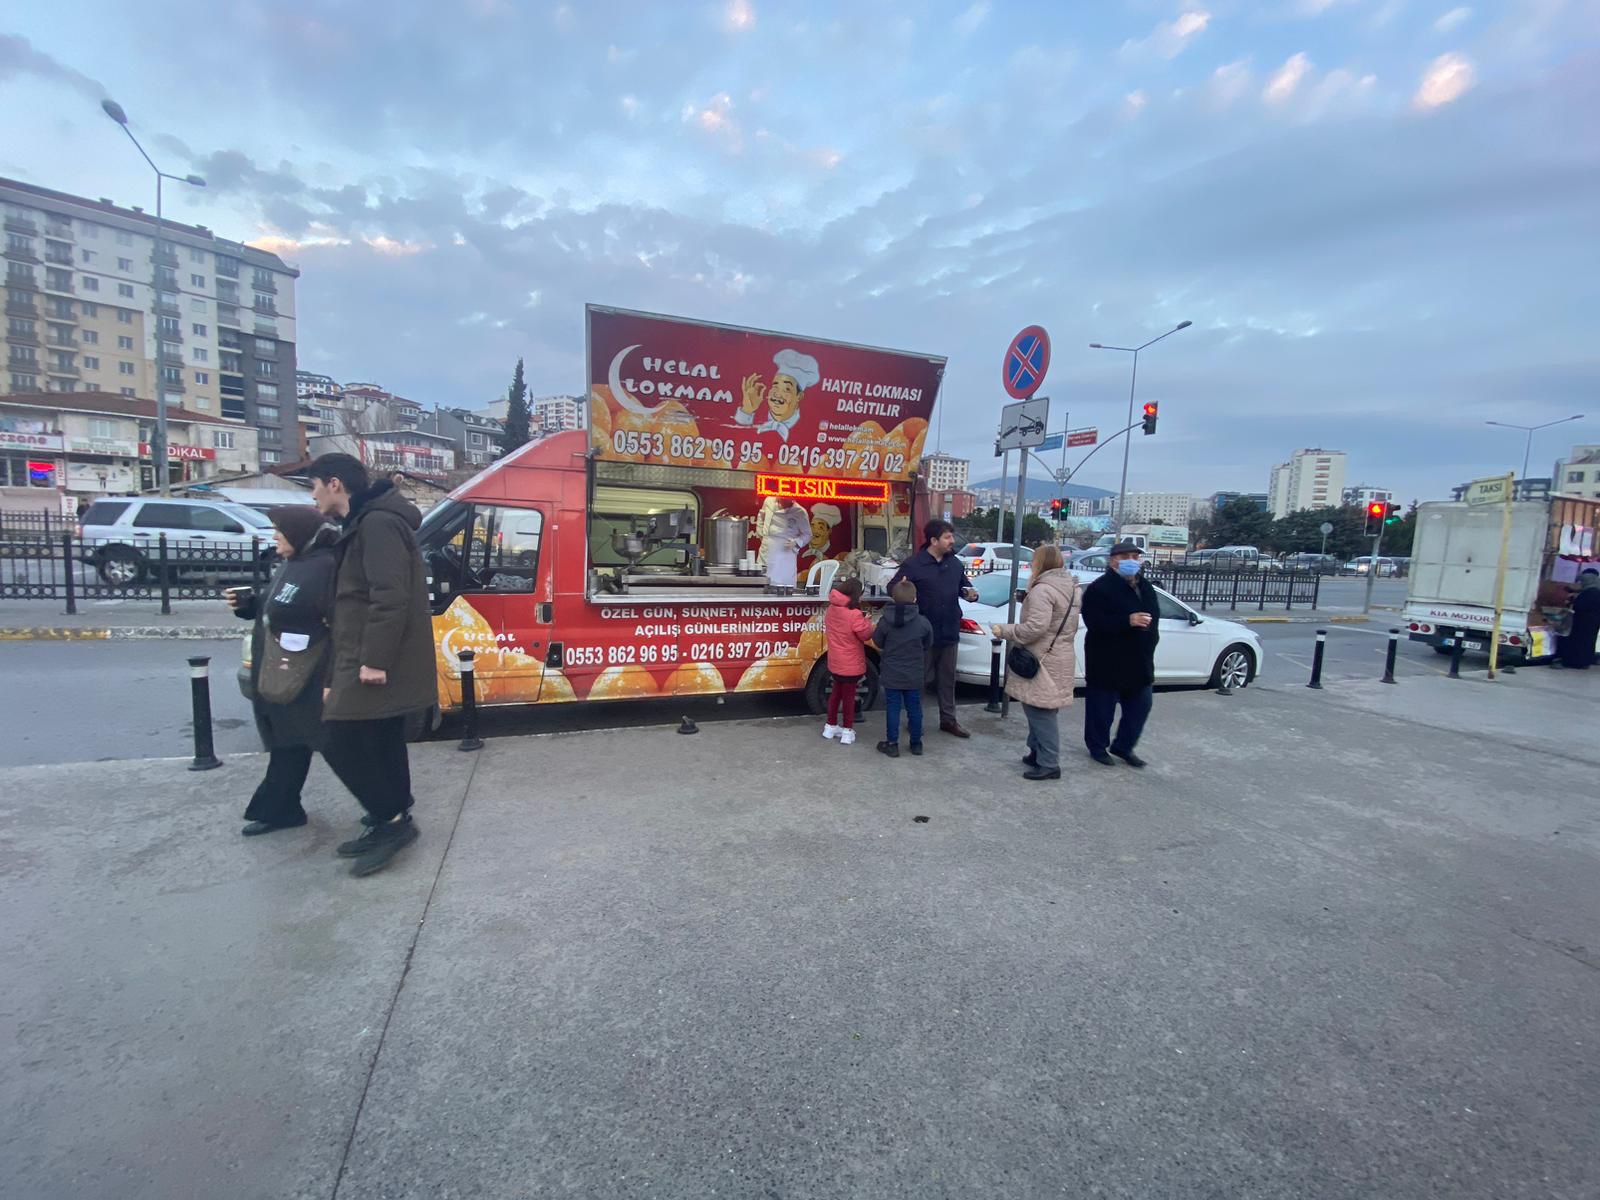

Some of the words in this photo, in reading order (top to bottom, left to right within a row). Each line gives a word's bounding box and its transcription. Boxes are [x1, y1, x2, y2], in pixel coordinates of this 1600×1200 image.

[643, 357, 720, 379] HELAL
[622, 378, 733, 403] LOKMAM
[821, 378, 862, 395] HAYIR
[865, 383, 922, 401] LOKMASI
[836, 398, 900, 417] DAĞITILIR
[613, 429, 664, 456] 0553
[671, 434, 705, 459] 862
[712, 438, 734, 461] 96
[740, 441, 763, 463] 95
[778, 444, 820, 467] 0216
[825, 448, 857, 469] 397
[860, 451, 880, 471] 20
[884, 453, 904, 473] 02
[601, 606, 639, 619] ÖZEL
[643, 606, 677, 620] GÜN,
[682, 605, 737, 619] SÜNNET,
[741, 605, 783, 619] NİŞAN,
[635, 624, 680, 638] AÇILIŞ
[684, 621, 779, 635] GÜNLERİNİZDE
[566, 647, 604, 665] 0553
[608, 645, 636, 663] 862
[640, 644, 658, 662] 96
[661, 644, 678, 661] 95
[691, 642, 724, 660] 0216
[727, 642, 752, 659] 397
[755, 641, 770, 657] 20
[774, 640, 790, 657] 02
